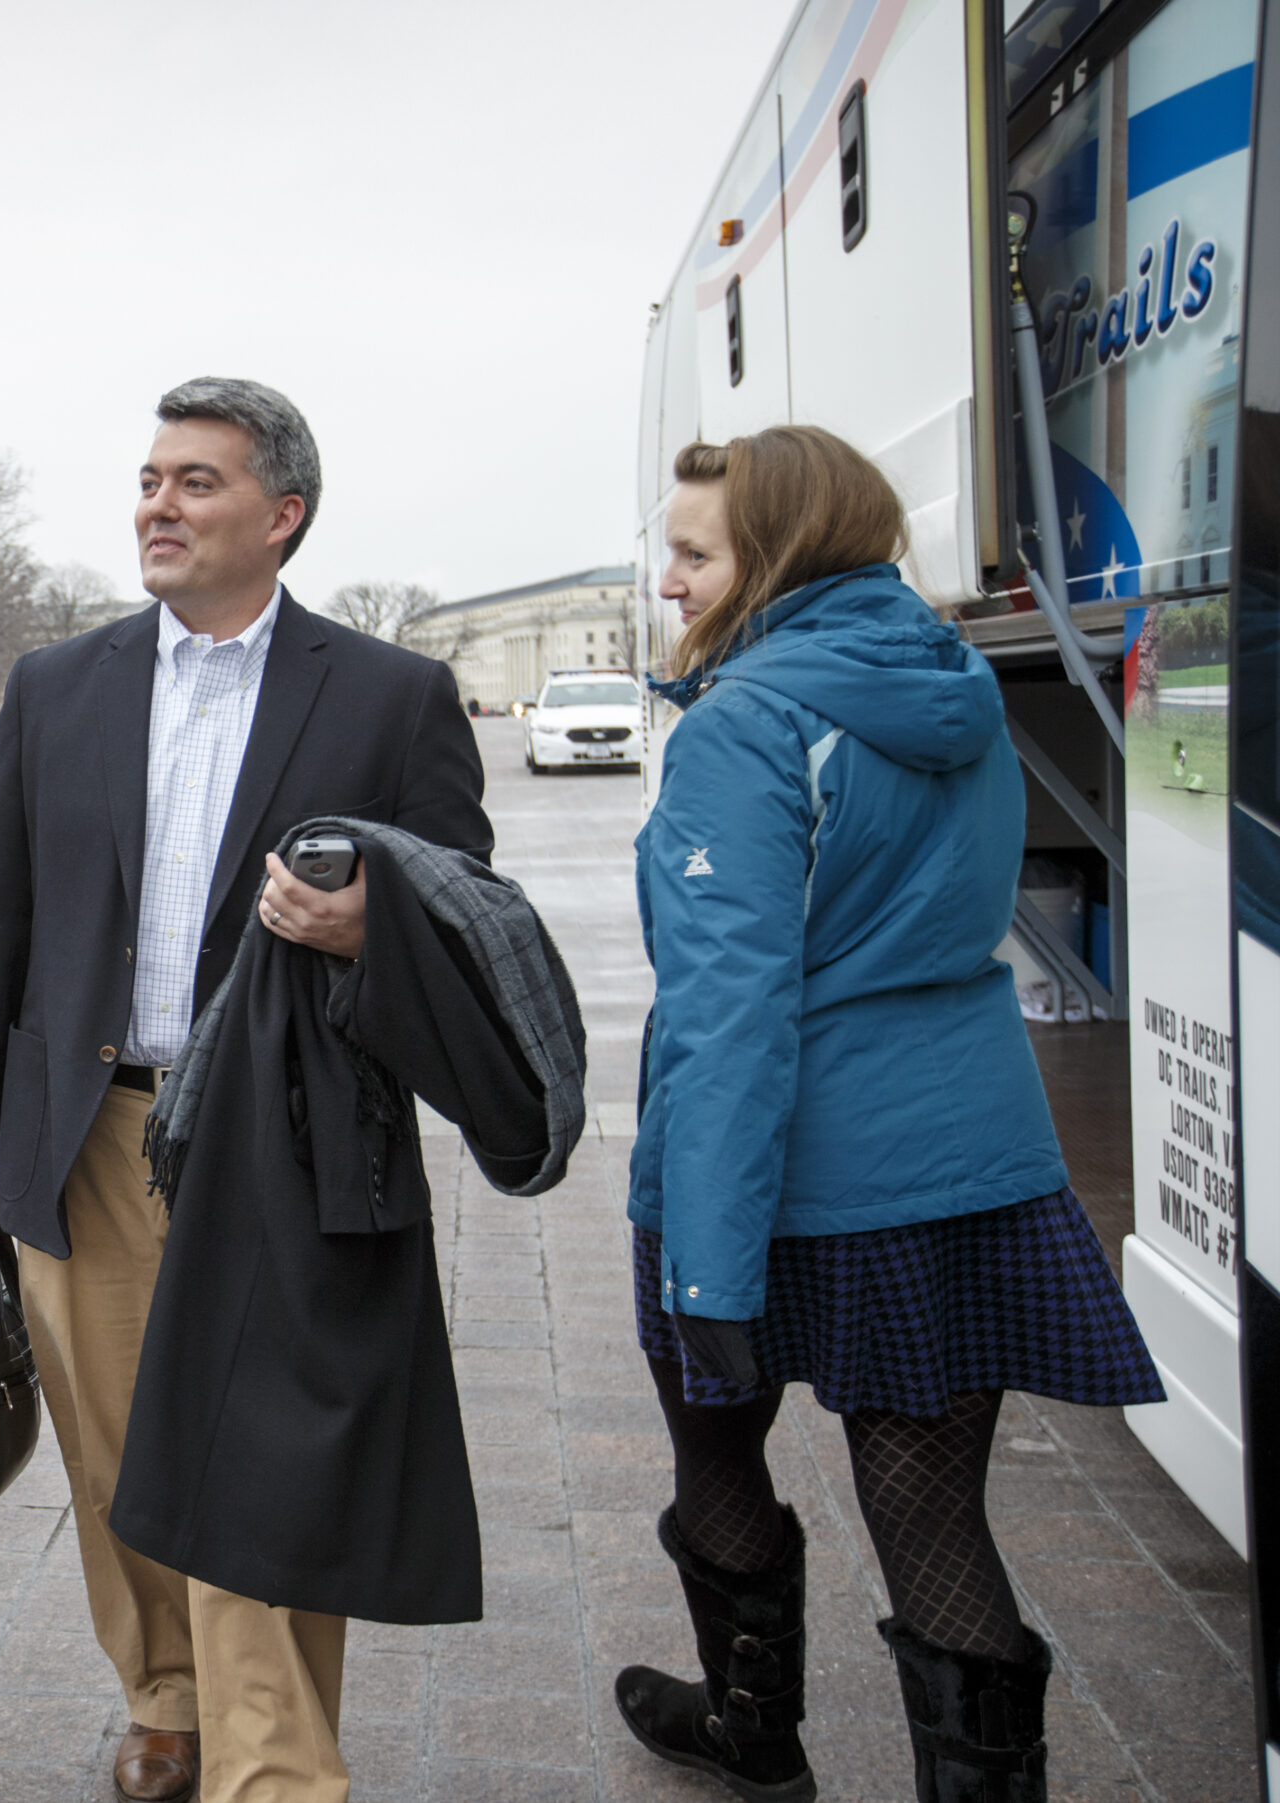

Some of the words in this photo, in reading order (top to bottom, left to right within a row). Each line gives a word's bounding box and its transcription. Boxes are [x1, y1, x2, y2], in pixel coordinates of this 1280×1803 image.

[1041, 217, 1217, 406] Trails
[1144, 997, 1176, 1044] OWNED
[1181, 1014, 1188, 1051] &
[1158, 1048, 1172, 1087] DC
[1170, 1099, 1218, 1164] LORTON,
[1163, 1138, 1198, 1194] USDOT
[1158, 1179, 1210, 1256] WMATC
